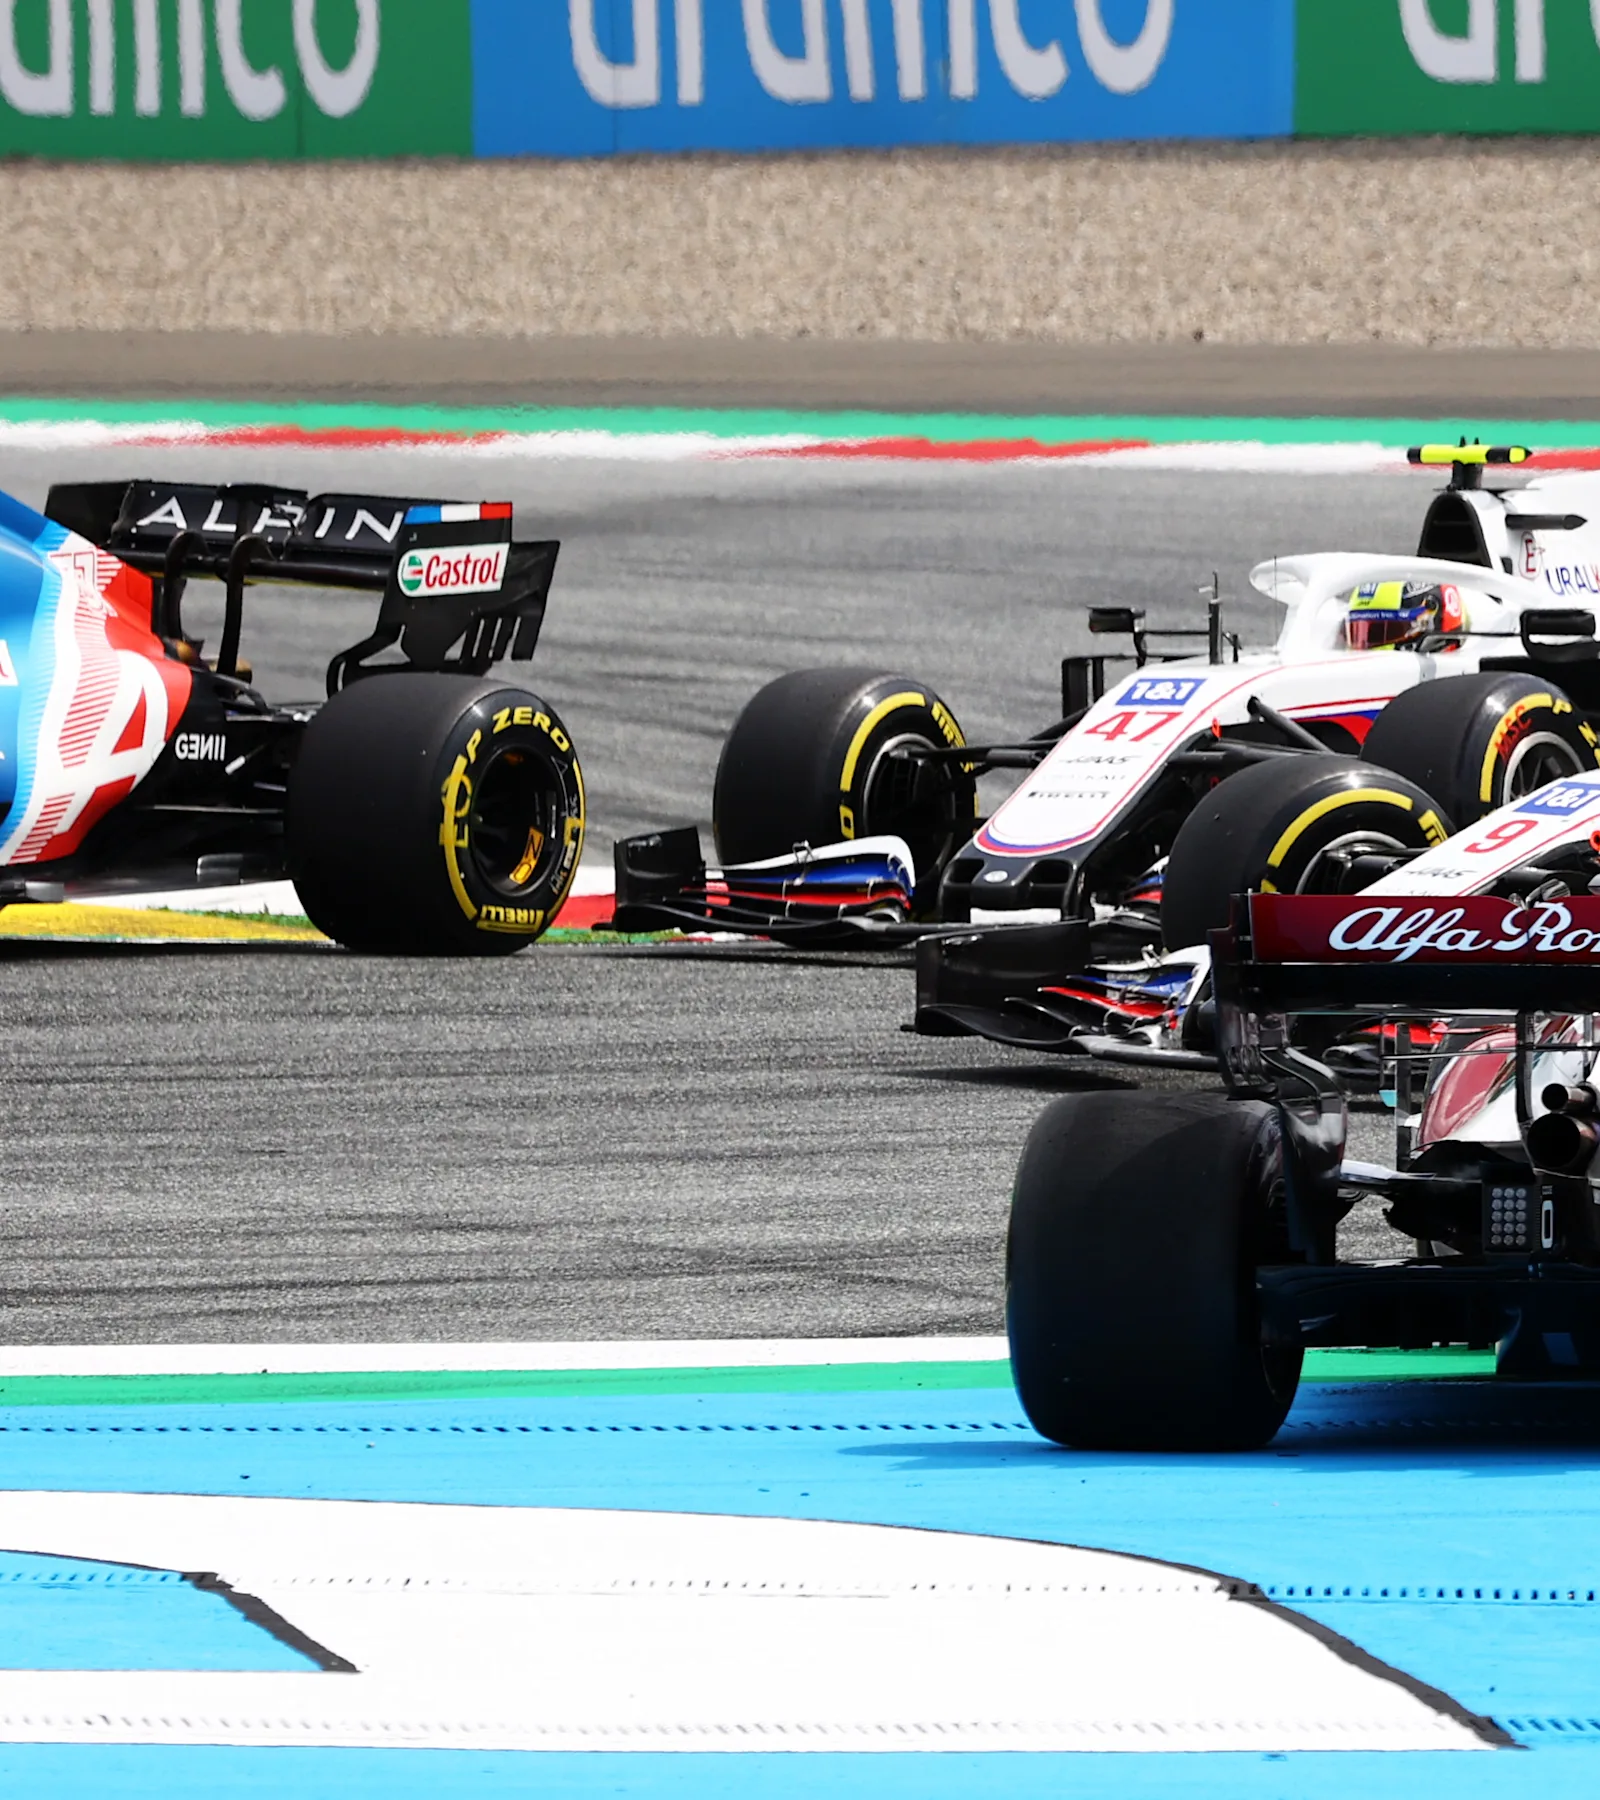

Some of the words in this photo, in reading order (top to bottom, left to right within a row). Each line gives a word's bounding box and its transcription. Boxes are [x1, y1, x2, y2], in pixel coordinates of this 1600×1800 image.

[424, 550, 502, 588] Castrol
[1130, 681, 1196, 700] 1&1
[492, 705, 571, 753] ZERO
[1083, 710, 1184, 743] 47
[1463, 819, 1539, 854] 9
[476, 904, 545, 934] PIRELLI
[1328, 906, 1493, 964] Alfa
